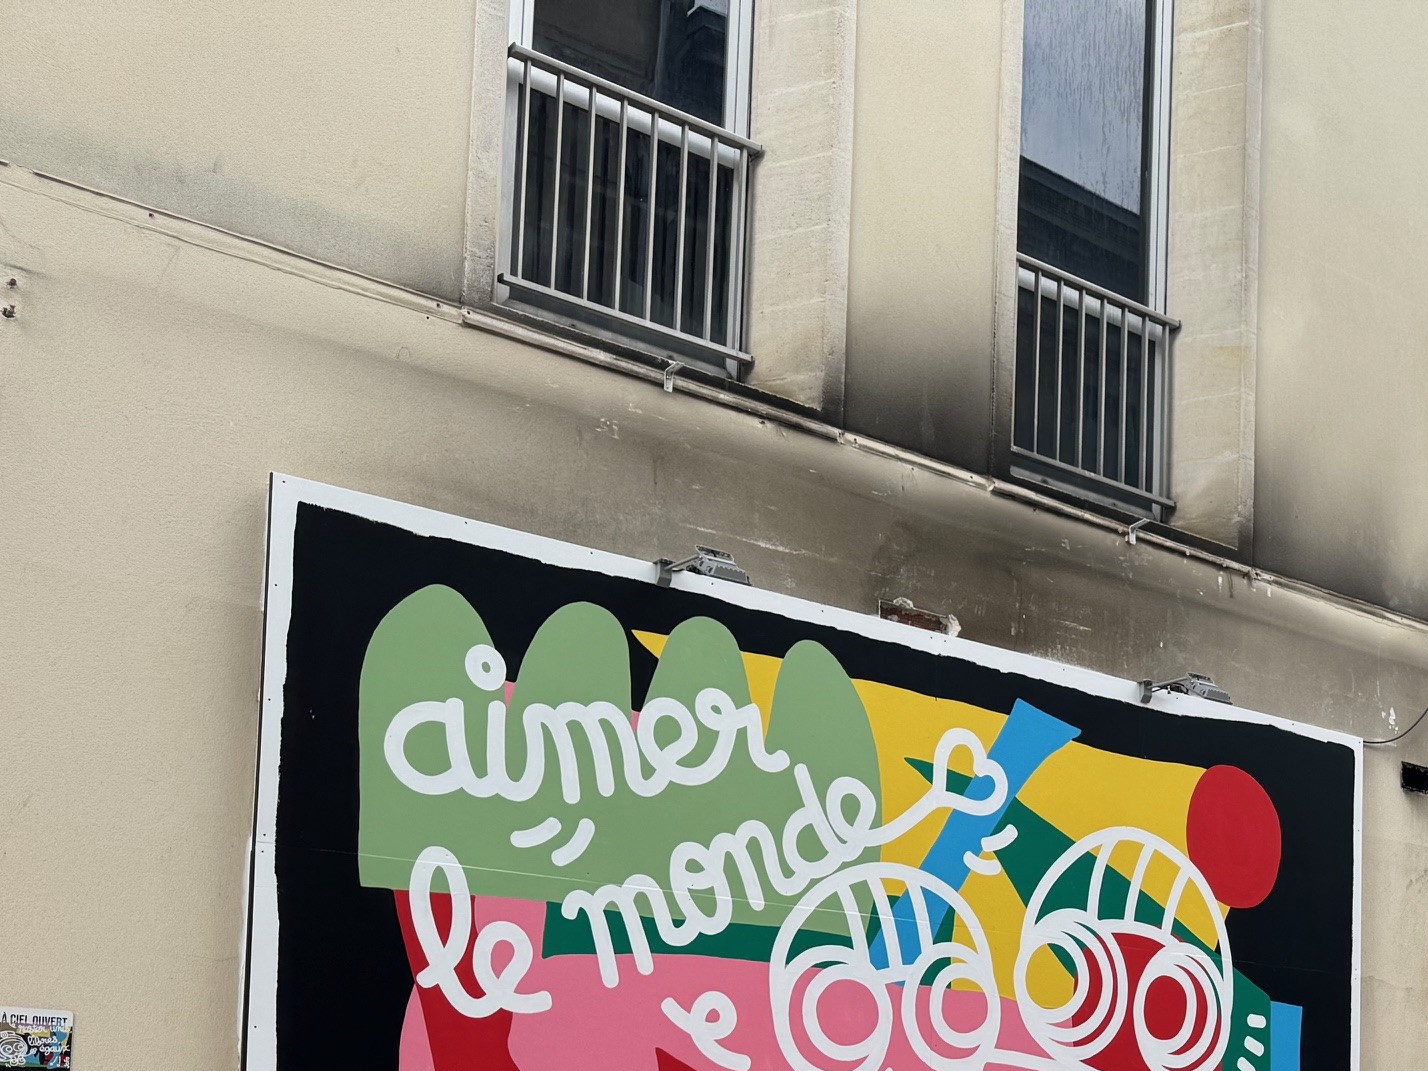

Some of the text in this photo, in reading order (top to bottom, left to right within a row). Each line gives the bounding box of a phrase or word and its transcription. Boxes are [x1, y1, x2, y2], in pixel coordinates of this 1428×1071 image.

[384, 644, 790, 804] aimer
[409, 763, 905, 1018] le monde
[33, 1015, 68, 1026] OUVERT
